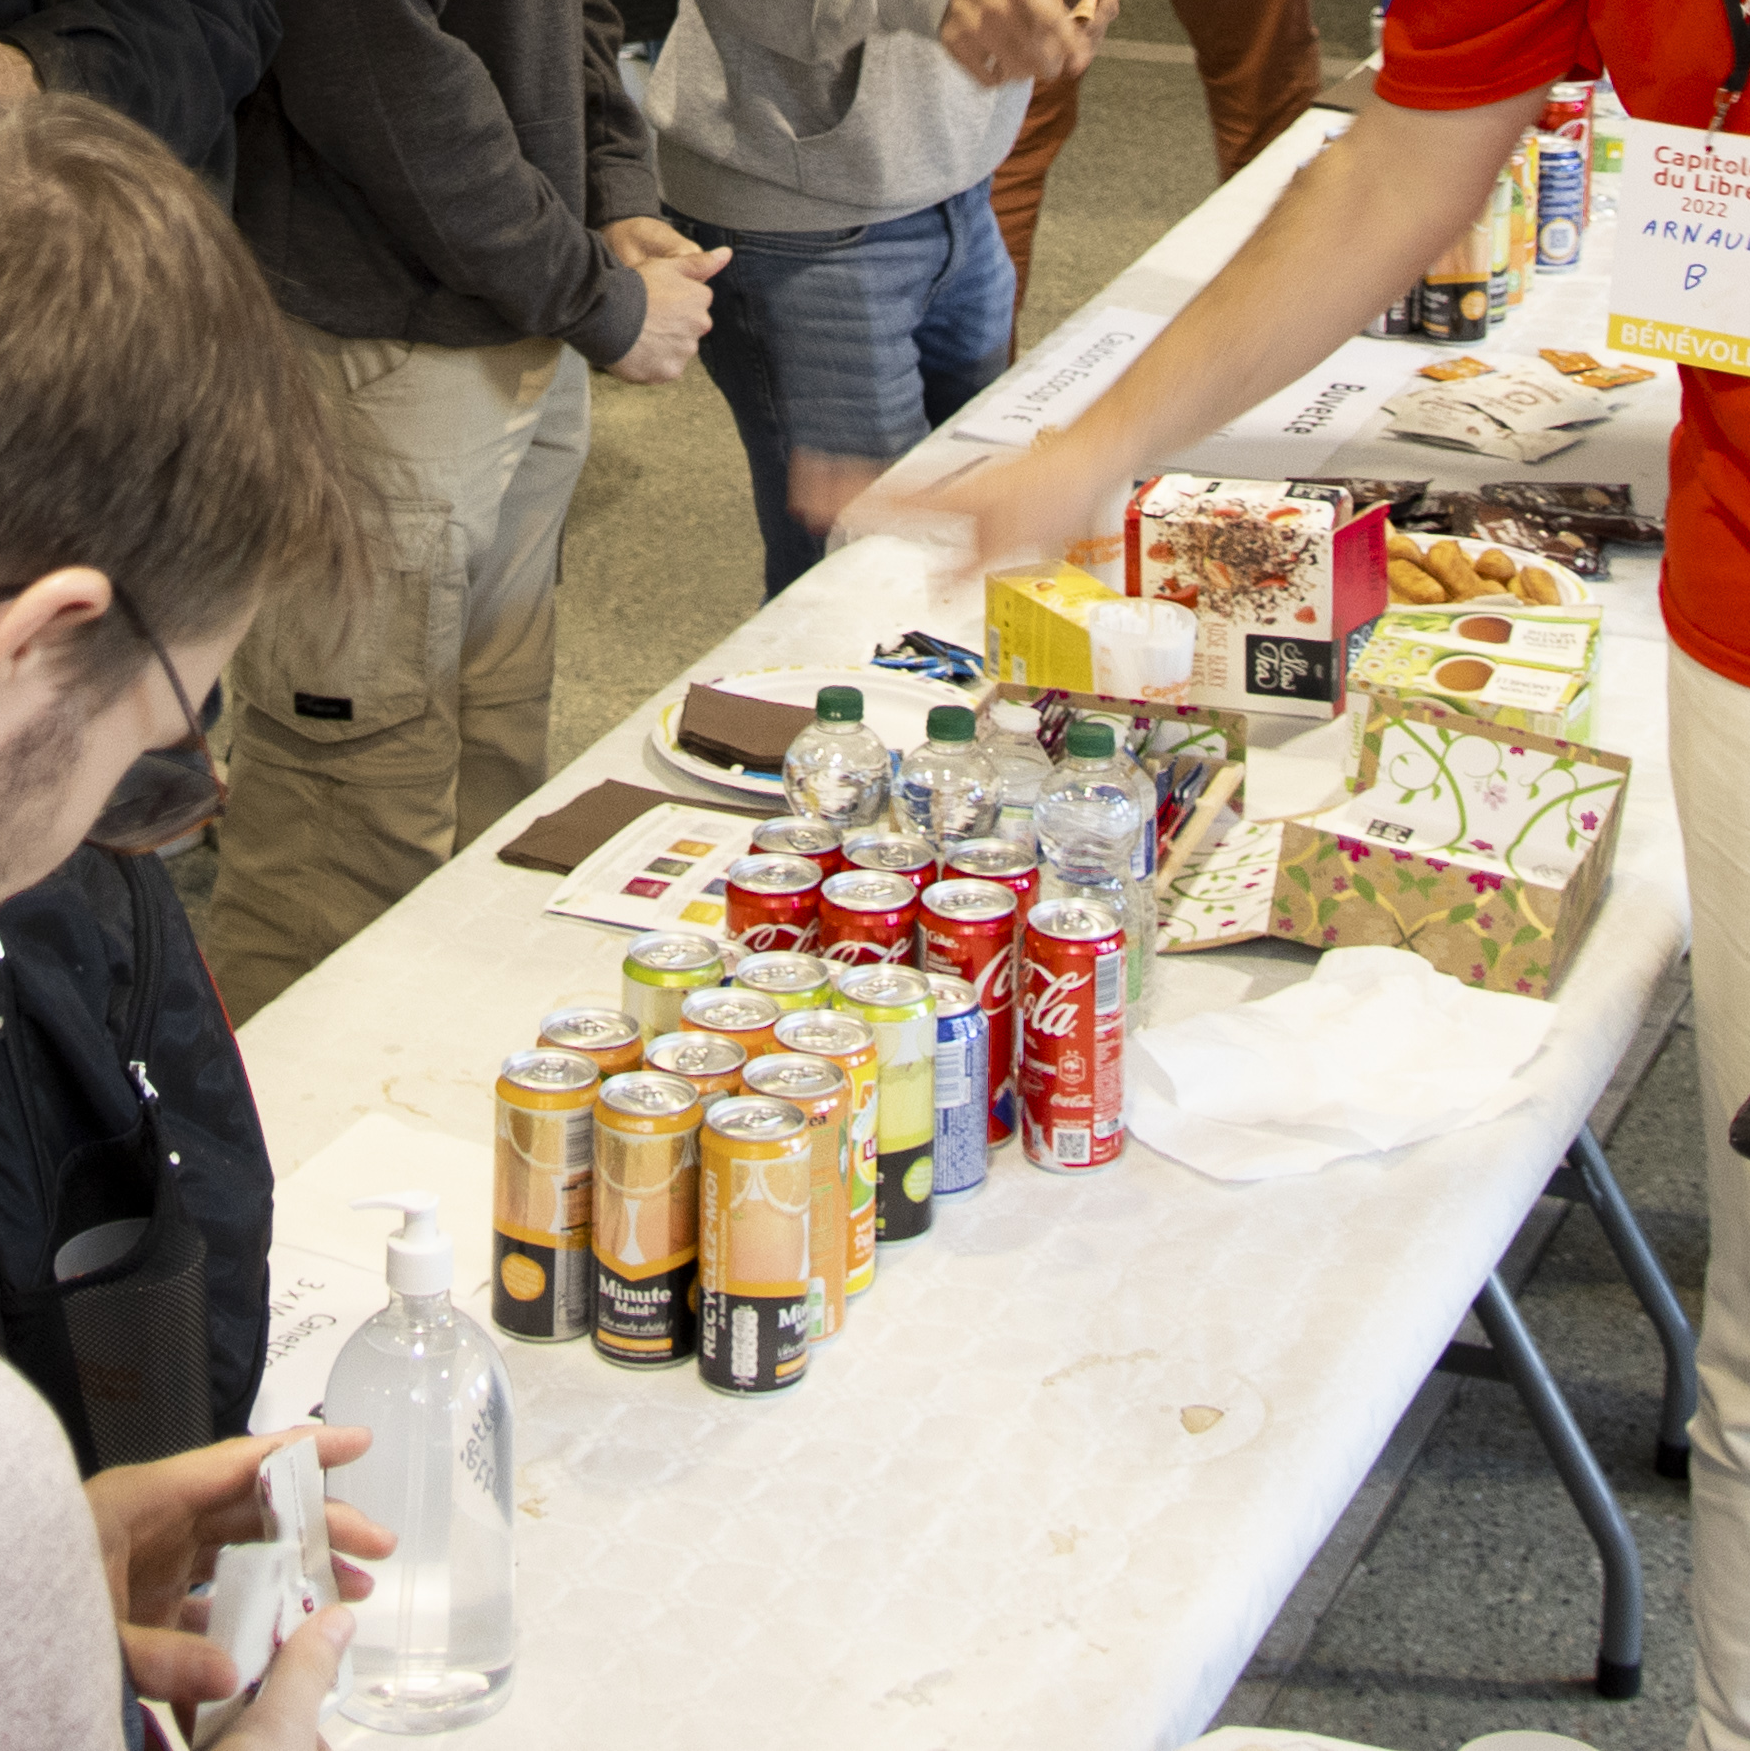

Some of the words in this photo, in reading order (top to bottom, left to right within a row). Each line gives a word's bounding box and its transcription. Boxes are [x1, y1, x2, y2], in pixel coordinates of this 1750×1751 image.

[1654, 167, 1686, 191] du
[1681, 196, 1729, 219] 2022
[1684, 263, 1707, 291] B
[1283, 381, 1367, 436] Buvette
[599, 1273, 673, 1304] Minute
